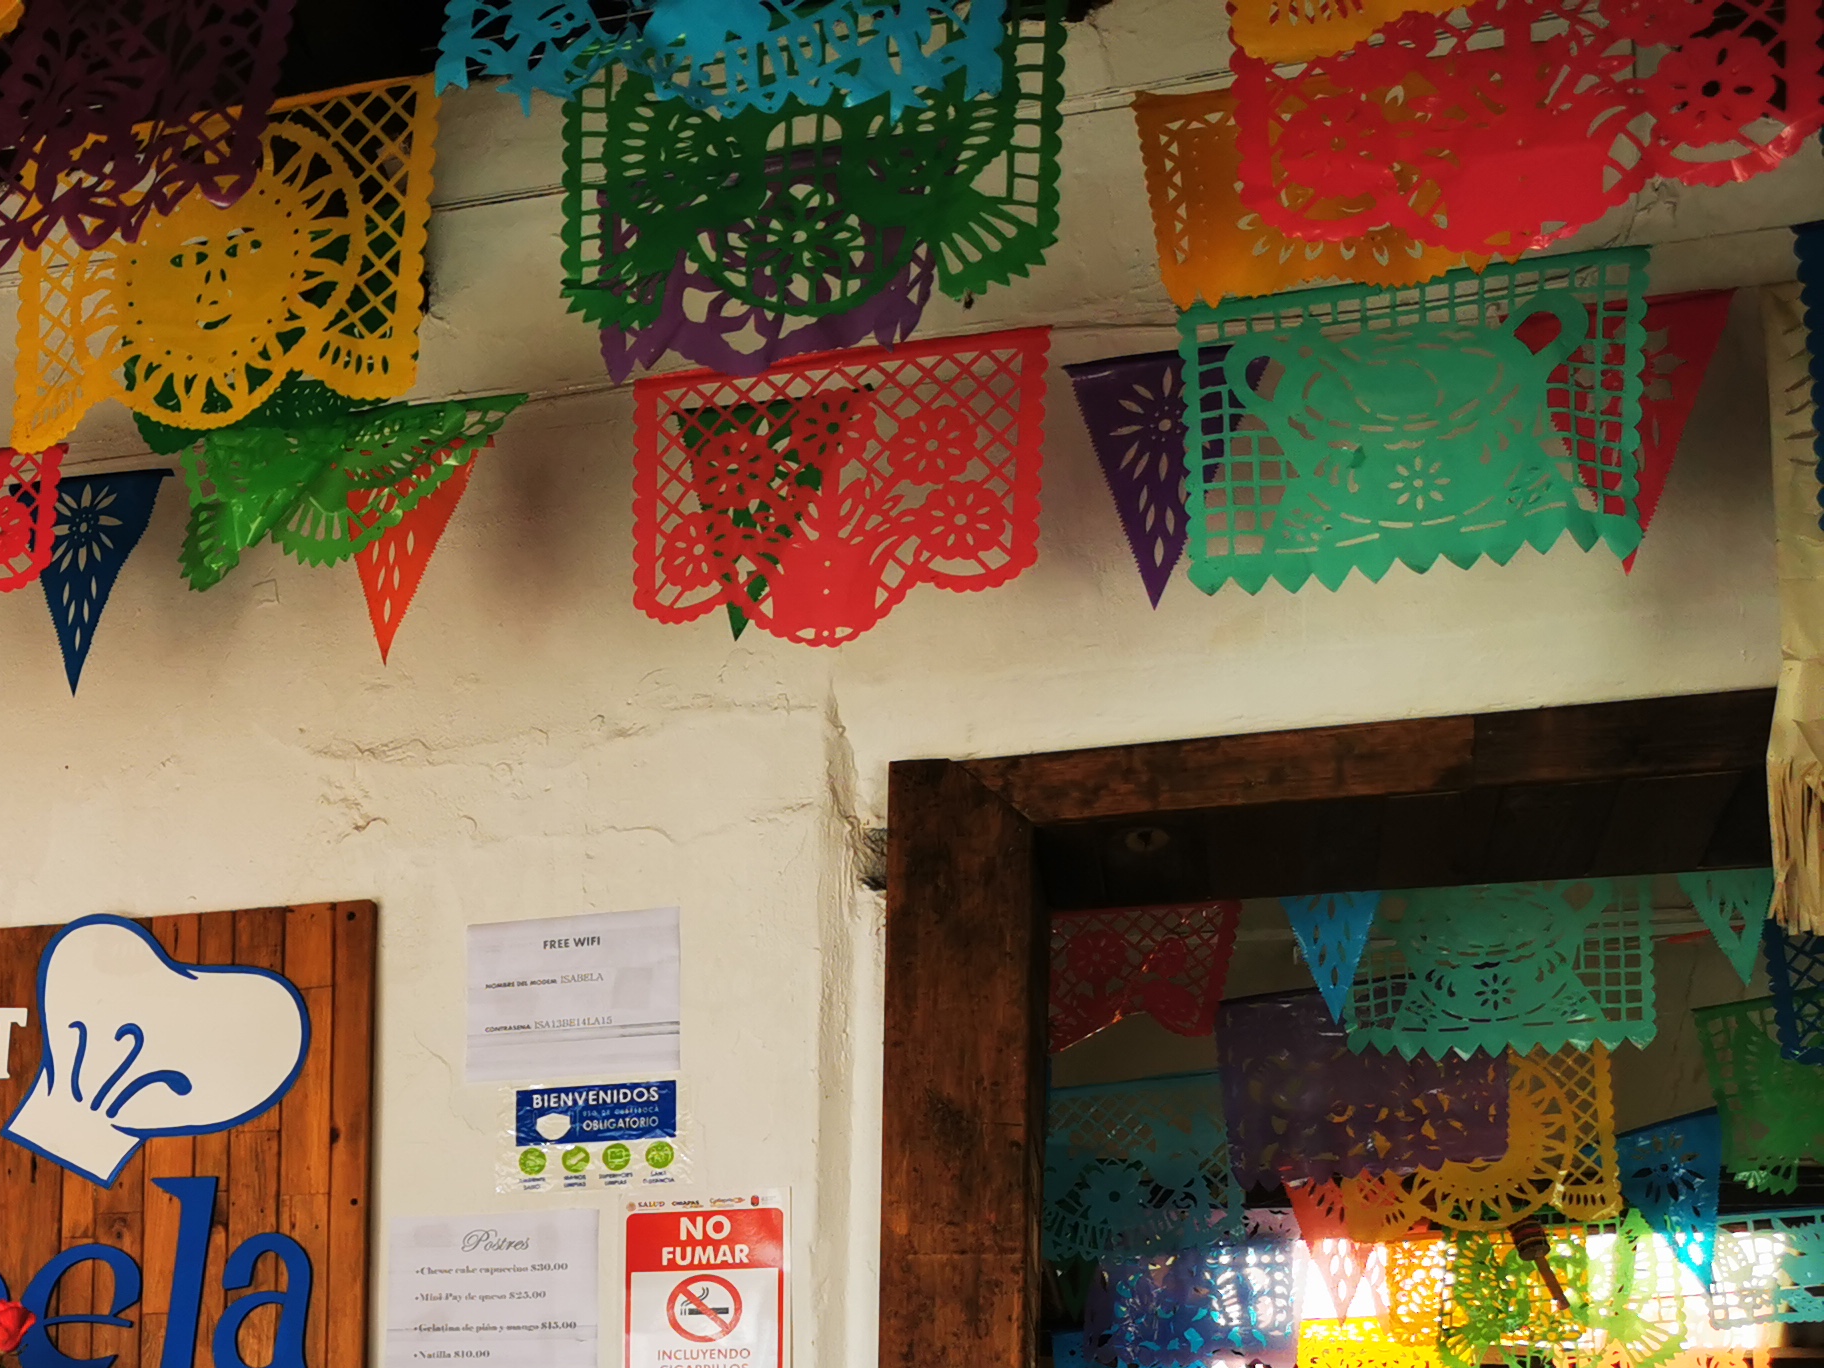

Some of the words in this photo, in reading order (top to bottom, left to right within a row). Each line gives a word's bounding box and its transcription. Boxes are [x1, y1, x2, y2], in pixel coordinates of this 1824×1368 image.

[543, 938, 570, 950] FREE
[573, 936, 601, 948] WIFI
[560, 973, 604, 984] ISABELA
[532, 1086, 659, 1109] BIENVENIDOS
[582, 1116, 659, 1131] OBLIGATORIO
[638, 1201, 665, 1209] SALUD
[679, 1215, 731, 1241] NO
[461, 1229, 530, 1252] Postres
[661, 1244, 750, 1266] FUMAR
[530, 1262, 568, 1272] $30.00
[508, 1290, 546, 1300] $25.00
[540, 1321, 577, 1330] $15.00
[419, 1350, 451, 1359] Natilla
[453, 1350, 490, 1358] $10.00
[657, 1348, 751, 1361] INCLUYENDO
